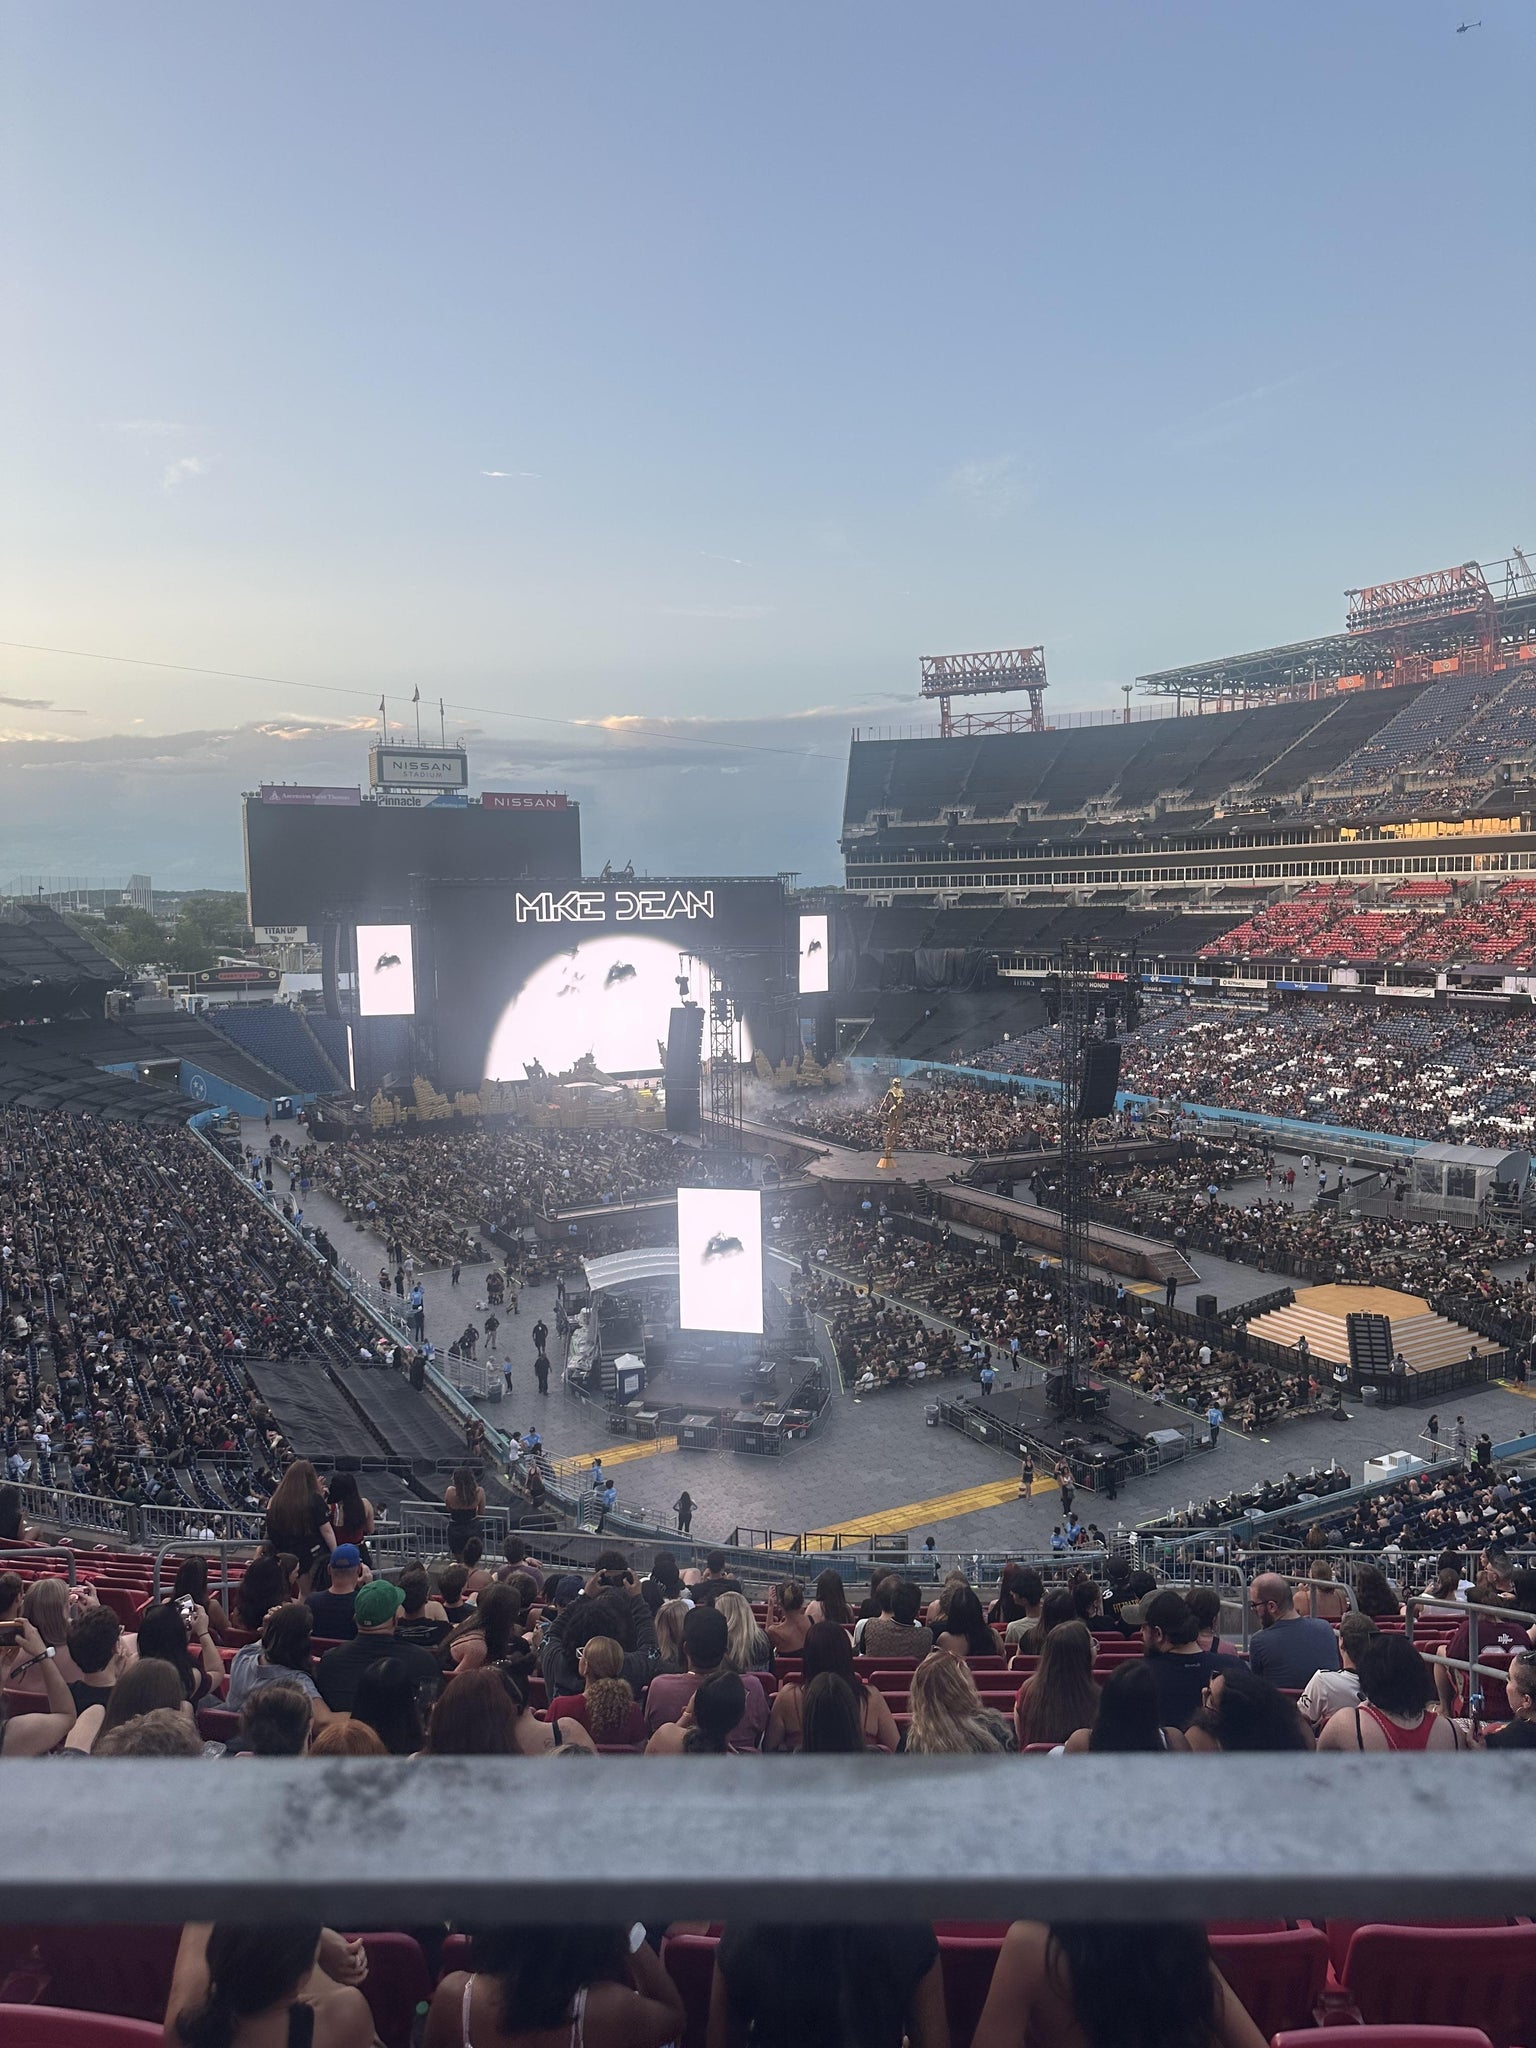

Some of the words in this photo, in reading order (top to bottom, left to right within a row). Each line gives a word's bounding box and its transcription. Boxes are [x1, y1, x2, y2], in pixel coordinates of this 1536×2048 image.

[393, 761, 452, 771] NISSAN
[378, 795, 422, 807] Pinnacle
[494, 797, 556, 808] NISSAN
[515, 890, 605, 923] MIKE
[615, 890, 714, 920] DEAN
[264, 927, 286, 935] TITAN
